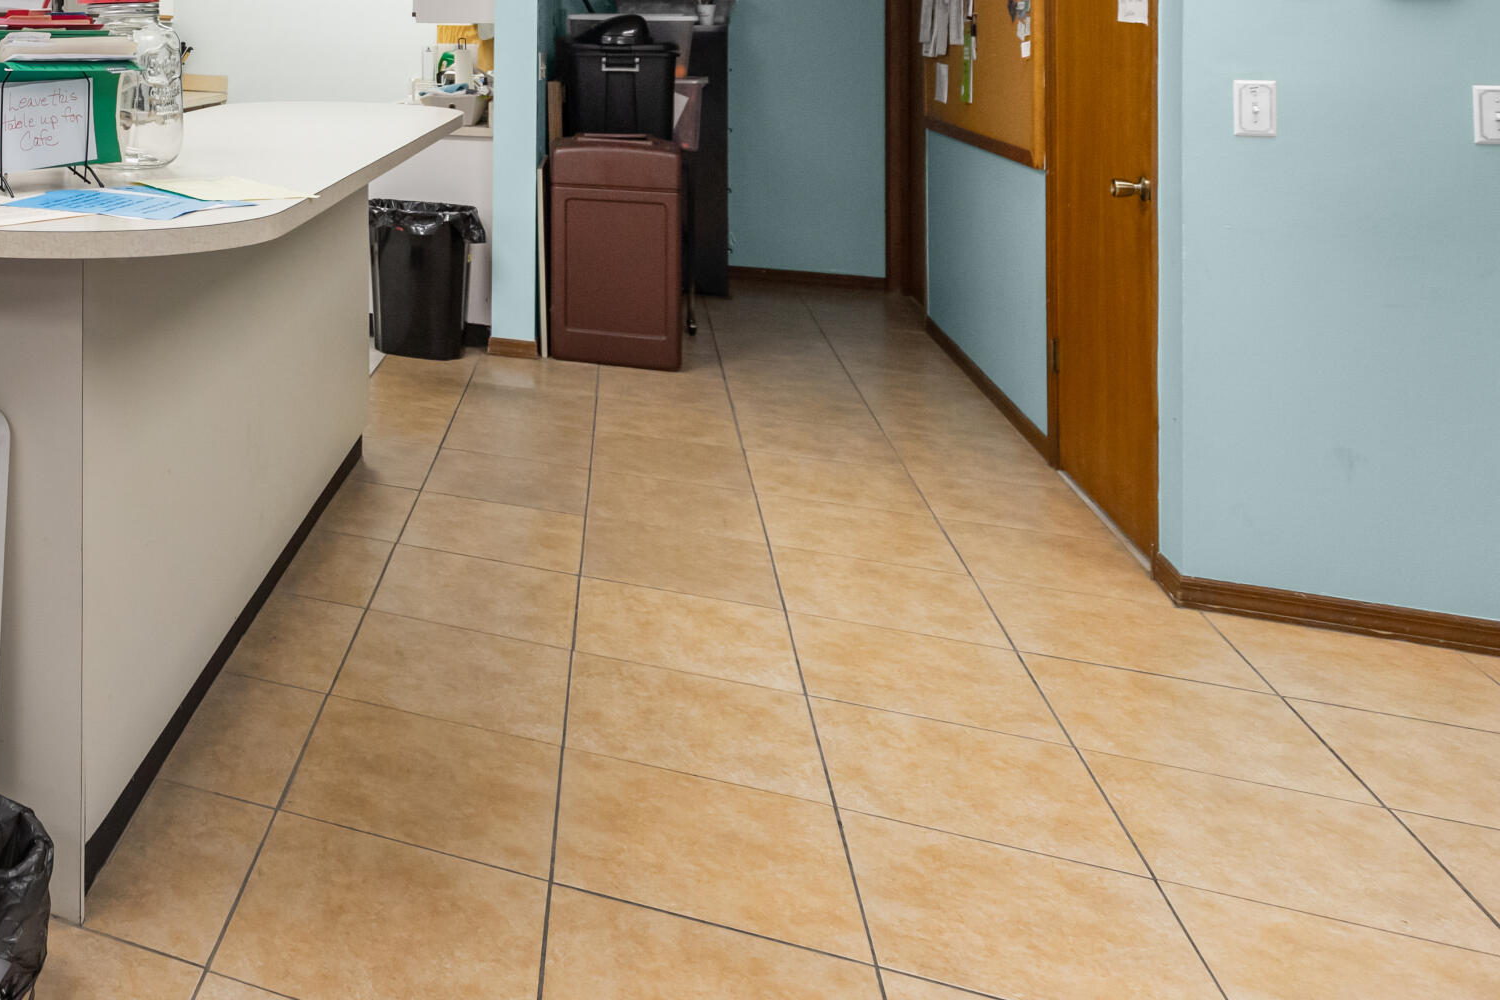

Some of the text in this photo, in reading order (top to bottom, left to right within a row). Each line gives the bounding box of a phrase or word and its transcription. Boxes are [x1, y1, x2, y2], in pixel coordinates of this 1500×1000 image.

[8, 88, 78, 112] Leave this
[40, 114, 59, 130] up
[61, 106, 83, 125] for
